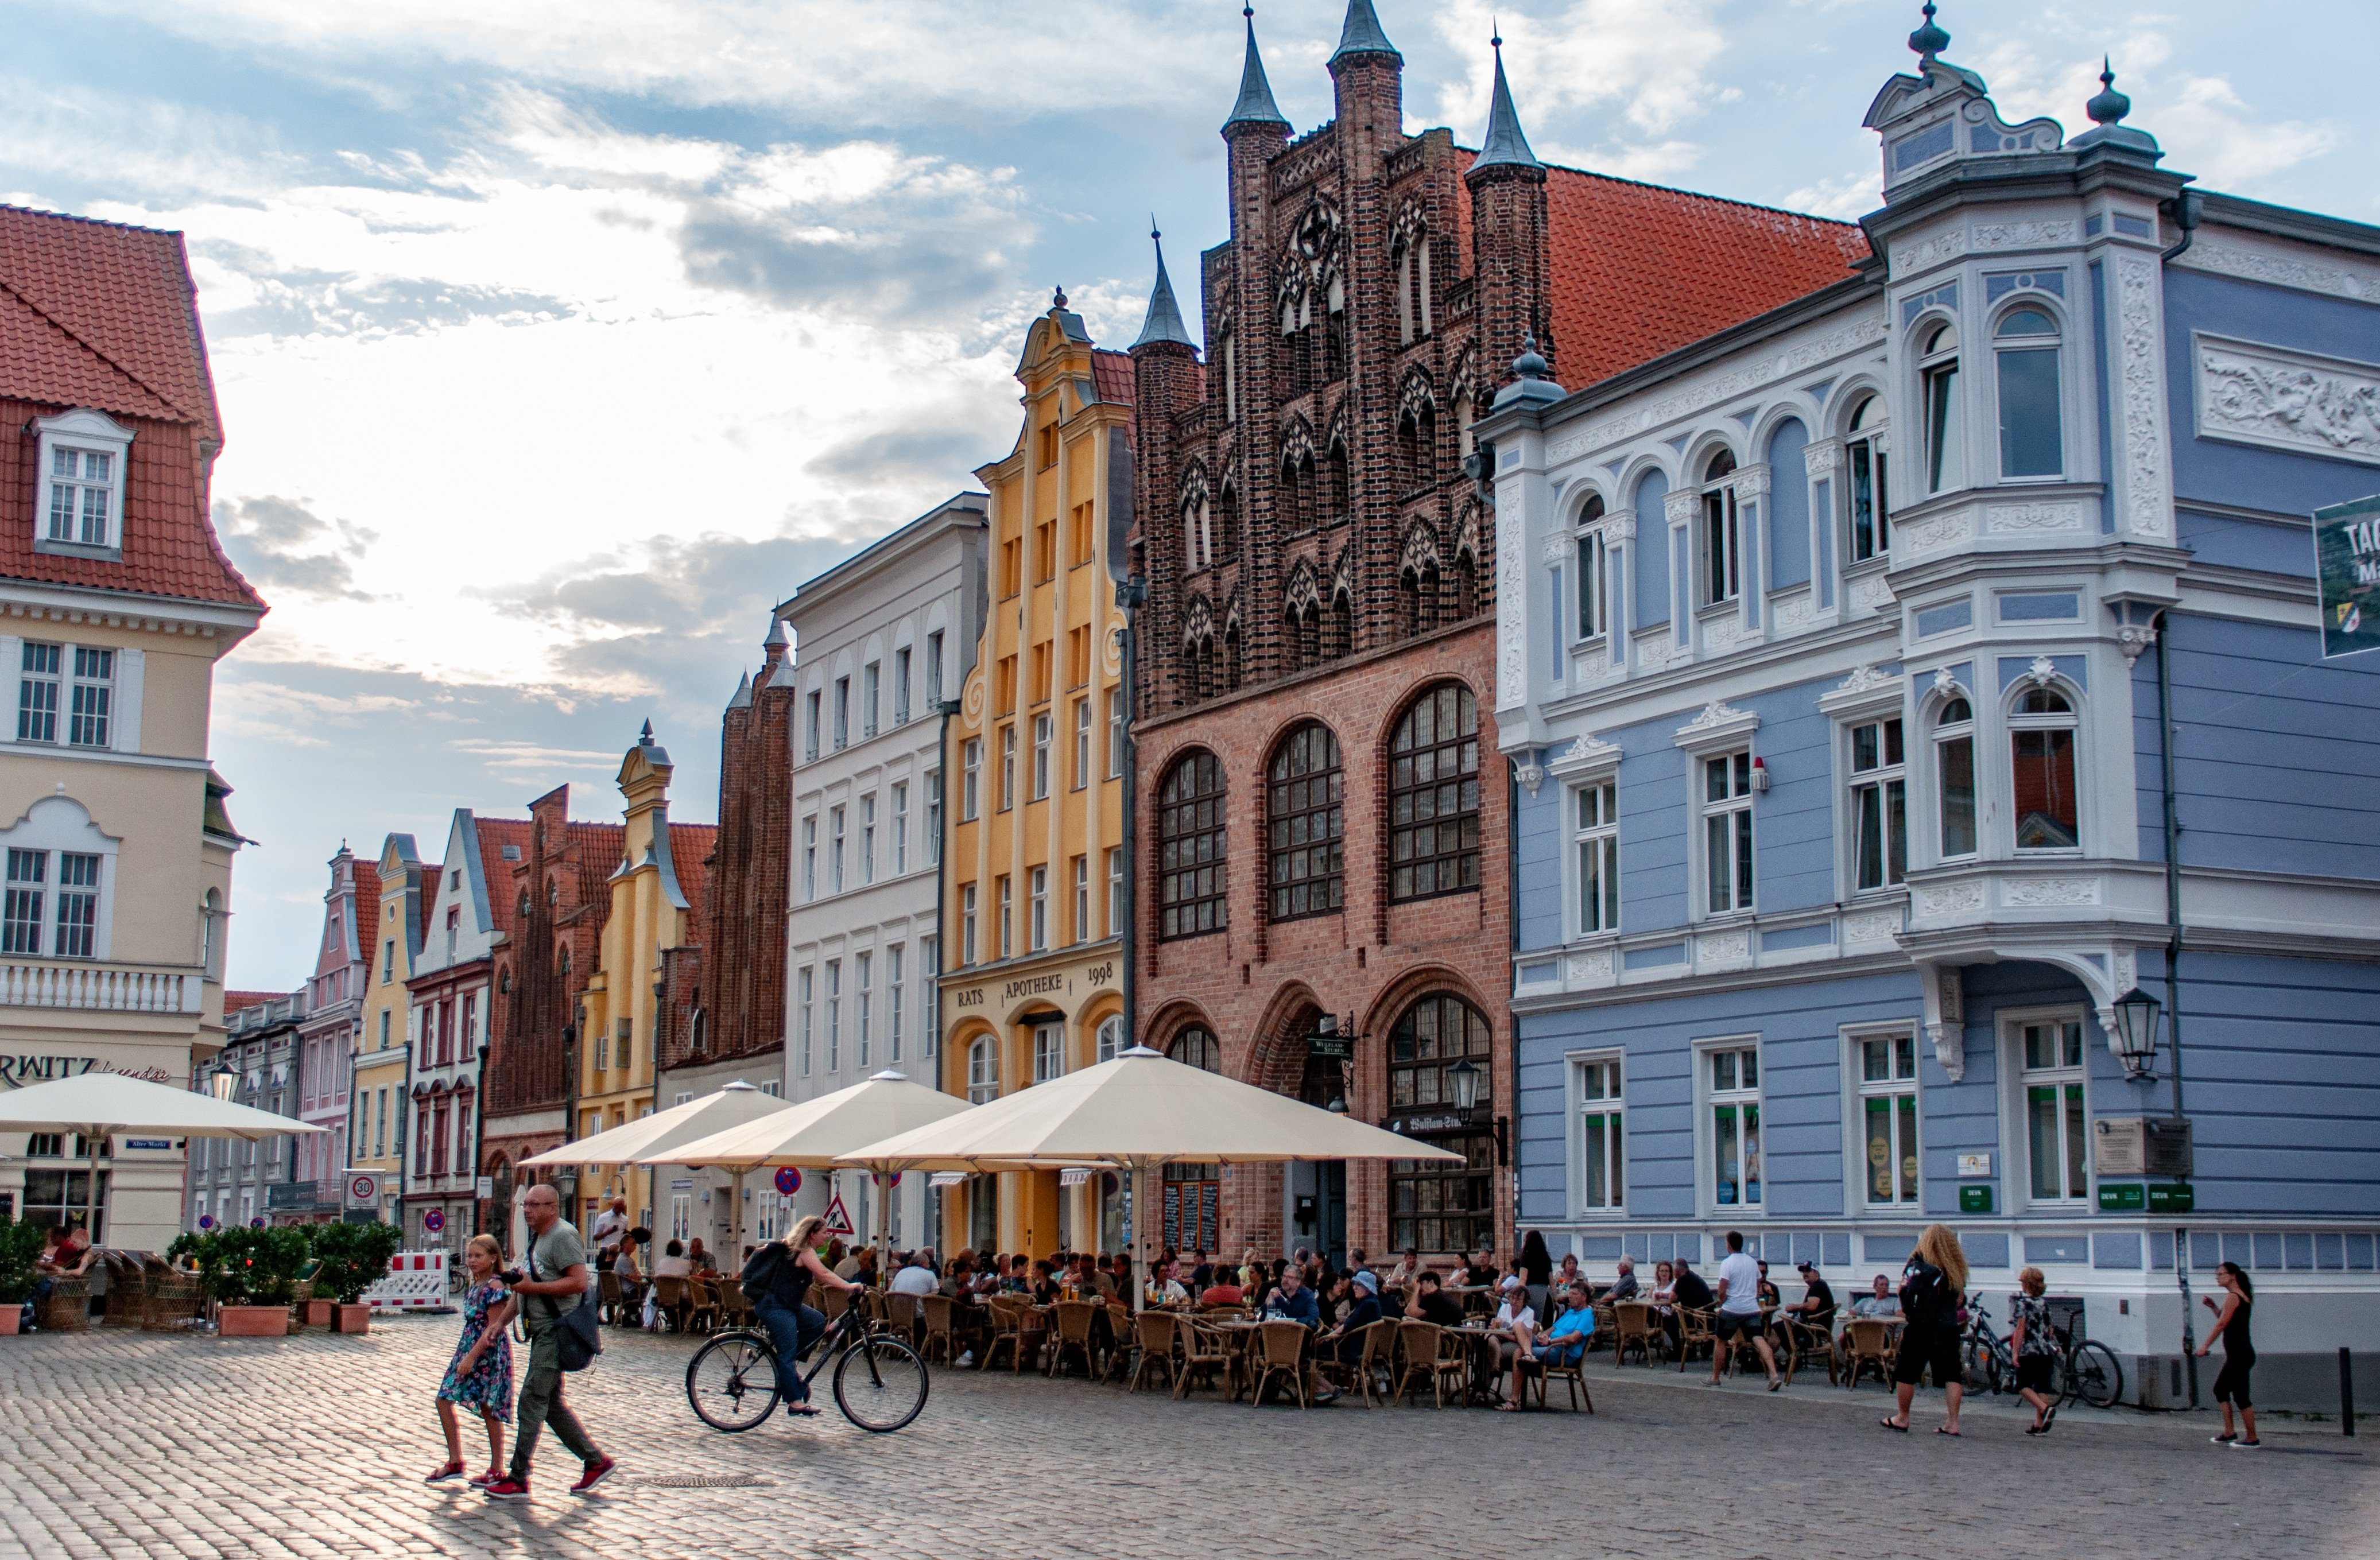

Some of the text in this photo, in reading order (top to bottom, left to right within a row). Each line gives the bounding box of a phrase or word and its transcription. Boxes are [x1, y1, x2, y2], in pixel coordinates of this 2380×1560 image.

[958, 961, 1113, 1007] RATS APOTHEKE 1998
[1410, 1116, 1472, 1131] Wulflam-Stu
[357, 1182, 370, 1192] 30
